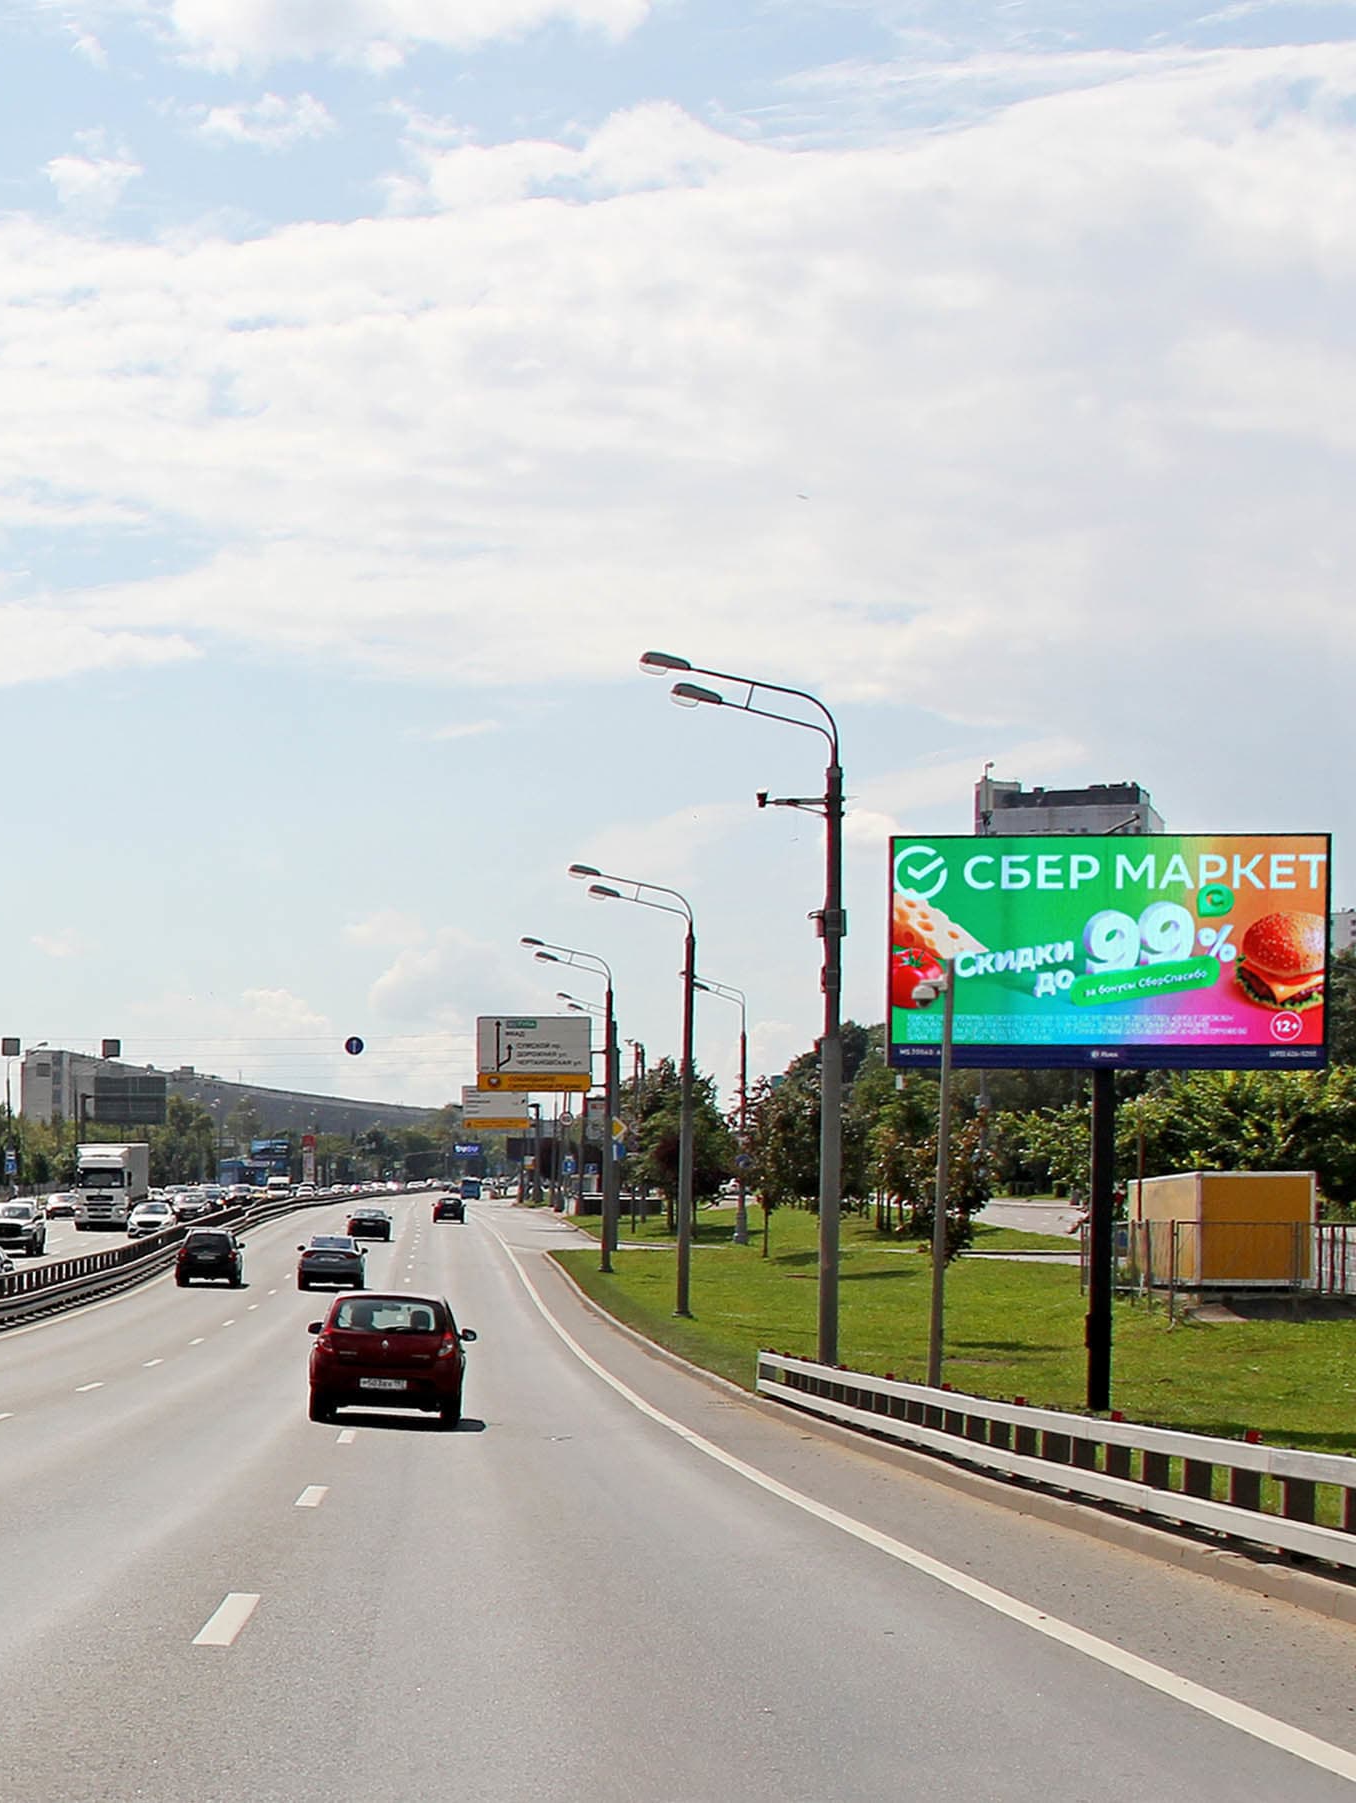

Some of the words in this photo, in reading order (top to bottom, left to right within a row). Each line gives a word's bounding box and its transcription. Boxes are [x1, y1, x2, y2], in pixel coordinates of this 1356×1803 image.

[963, 853, 1100, 890] СБЕР
[1115, 853, 1327, 890] МАРКЕТ
[954, 940, 1074, 978] Скидки
[1033, 969, 1075, 998] до
[1098, 981, 1136, 995] бонусы
[1138, 970, 1208, 988] СберСпасибо
[1276, 1020, 1299, 1033] 12+
